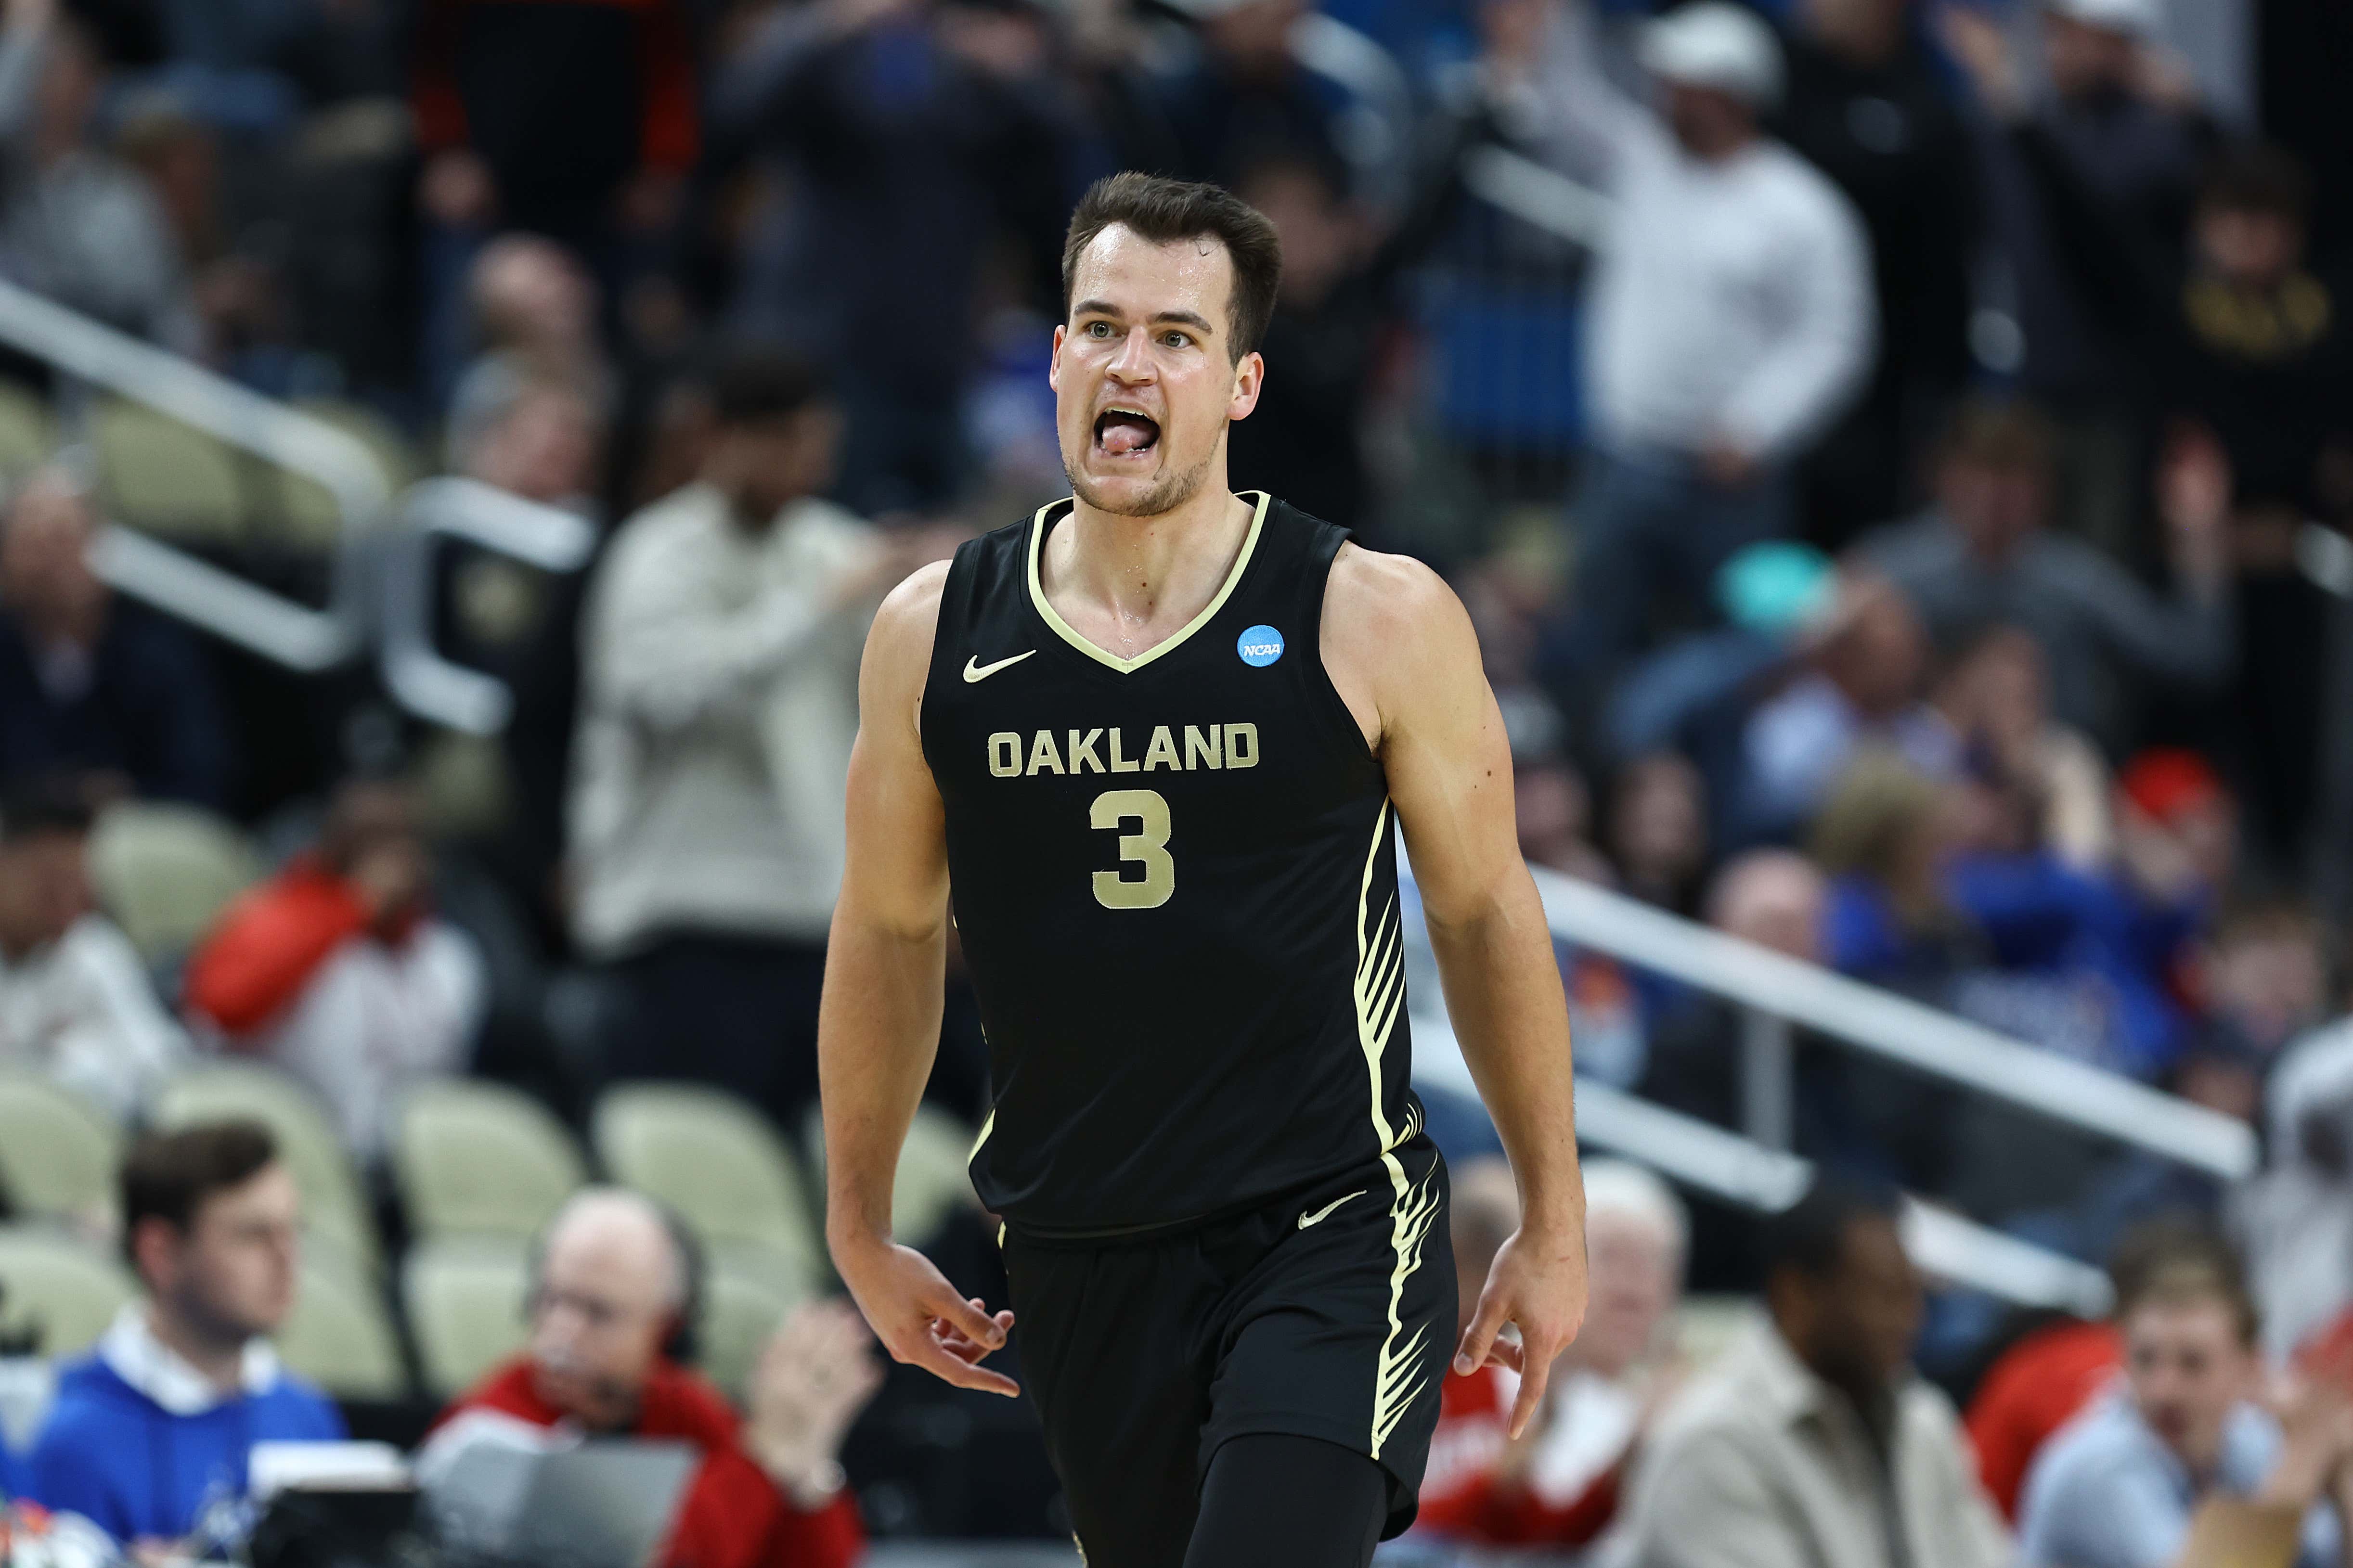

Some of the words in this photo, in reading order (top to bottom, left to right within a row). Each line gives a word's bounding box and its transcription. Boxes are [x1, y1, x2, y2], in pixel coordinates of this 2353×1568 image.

[1244, 643, 1280, 656] NCAA
[988, 723, 1259, 777] OAKLAND
[1089, 790, 1175, 909] 3
